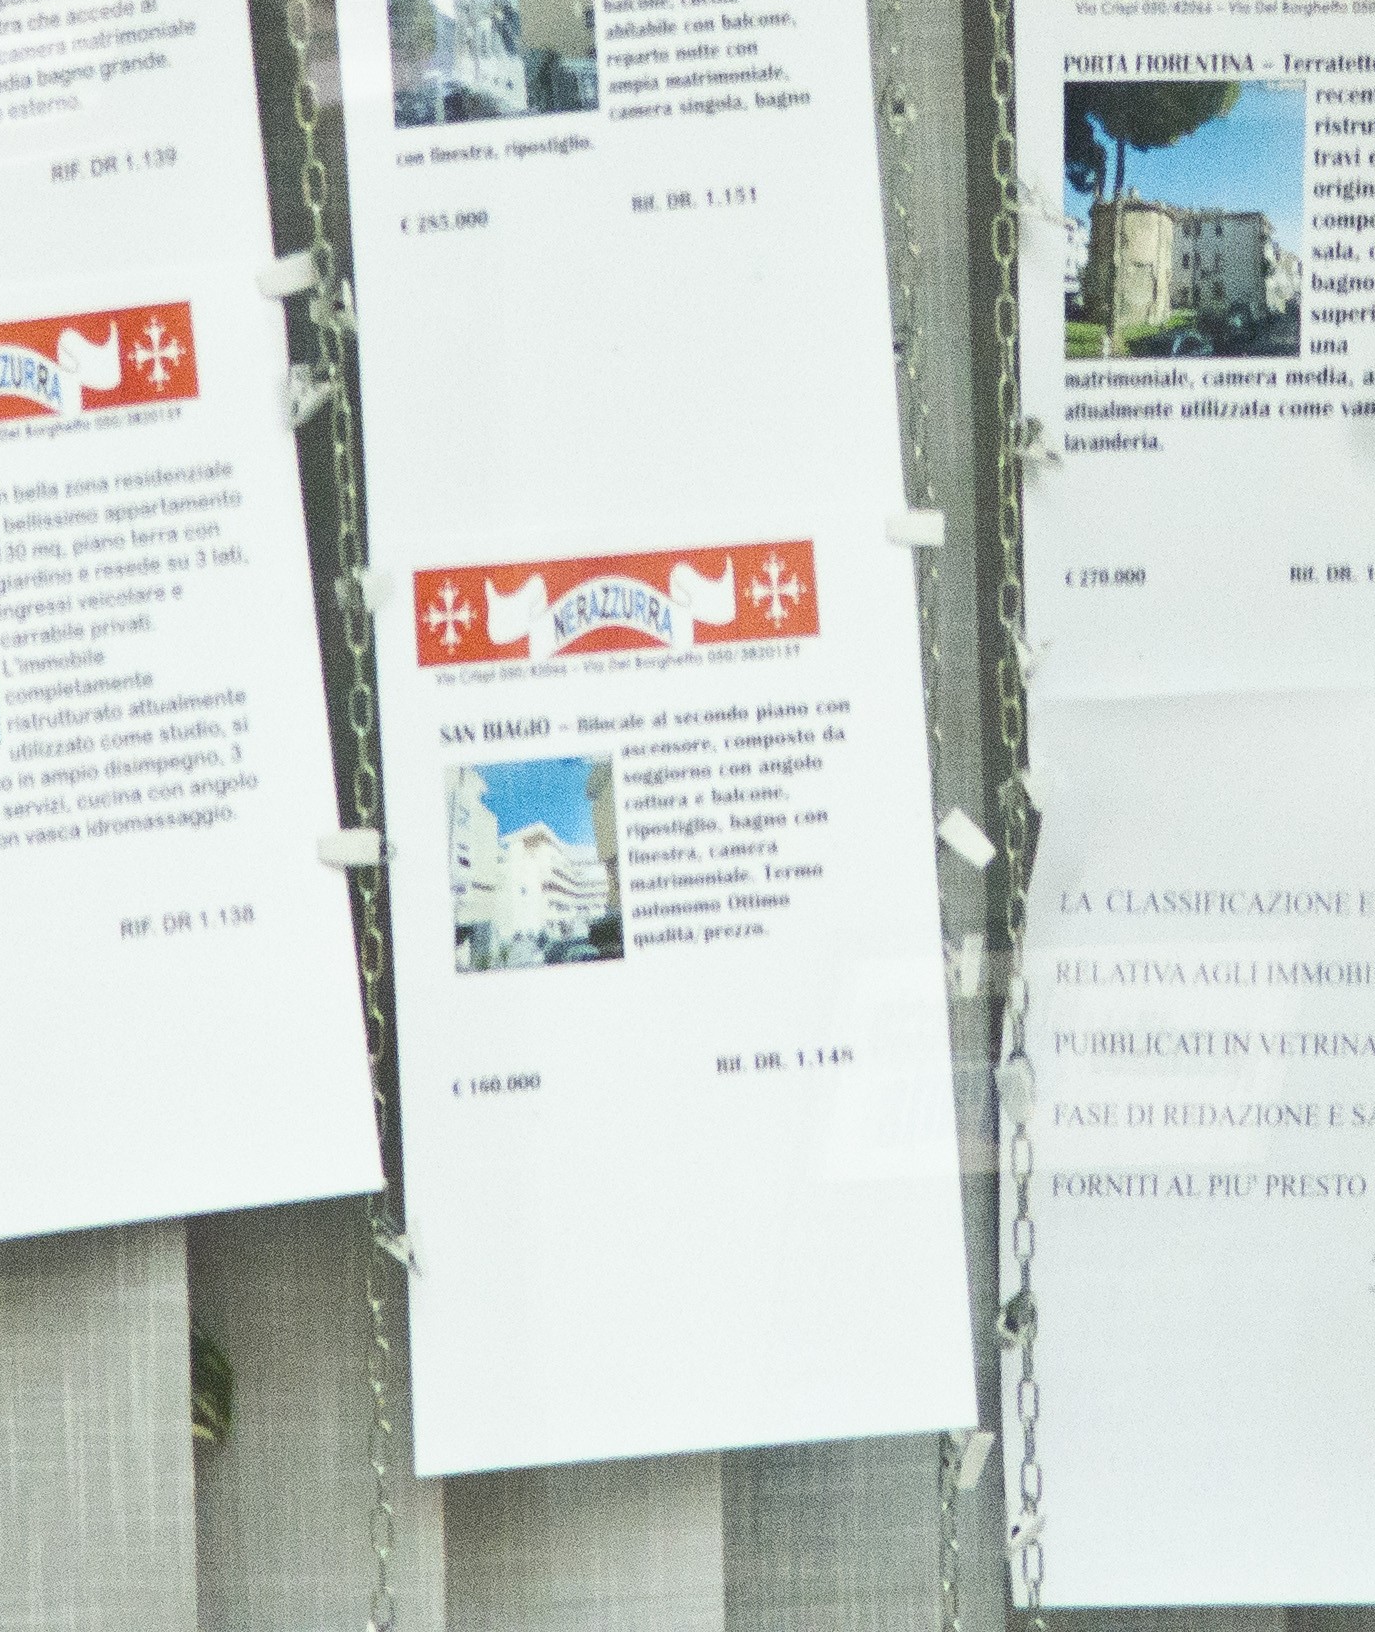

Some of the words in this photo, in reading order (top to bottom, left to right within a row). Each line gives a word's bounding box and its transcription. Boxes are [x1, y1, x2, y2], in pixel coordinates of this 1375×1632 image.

[1063, 53, 1128, 73] PORTA
[1135, 53, 1255, 73] FIORENTINA
[1312, 148, 1361, 167] travi
[1311, 241, 1359, 261] sala,
[1309, 339, 1349, 355] una
[553, 585, 672, 641] NERAZZURRA
[482, 717, 552, 741] BIAGIO
[1058, 889, 1093, 914] LA
[1104, 889, 1351, 917] CLASSIFICAZIONE
[1055, 961, 1187, 985] RELATIVA
[1195, 961, 1258, 985] AGLI
[1053, 1030, 1215, 1057] PUBBLICATI
[1223, 1032, 1250, 1056] IN
[1053, 1103, 1119, 1128] FASE
[1127, 1104, 1154, 1126] DI
[1163, 1103, 1318, 1128] REDAZIONE
[1328, 1103, 1342, 1128] E
[1051, 1172, 1159, 1197] FORNITI
[1169, 1173, 1200, 1198] AL
[1265, 1173, 1368, 1197] PRESTO
